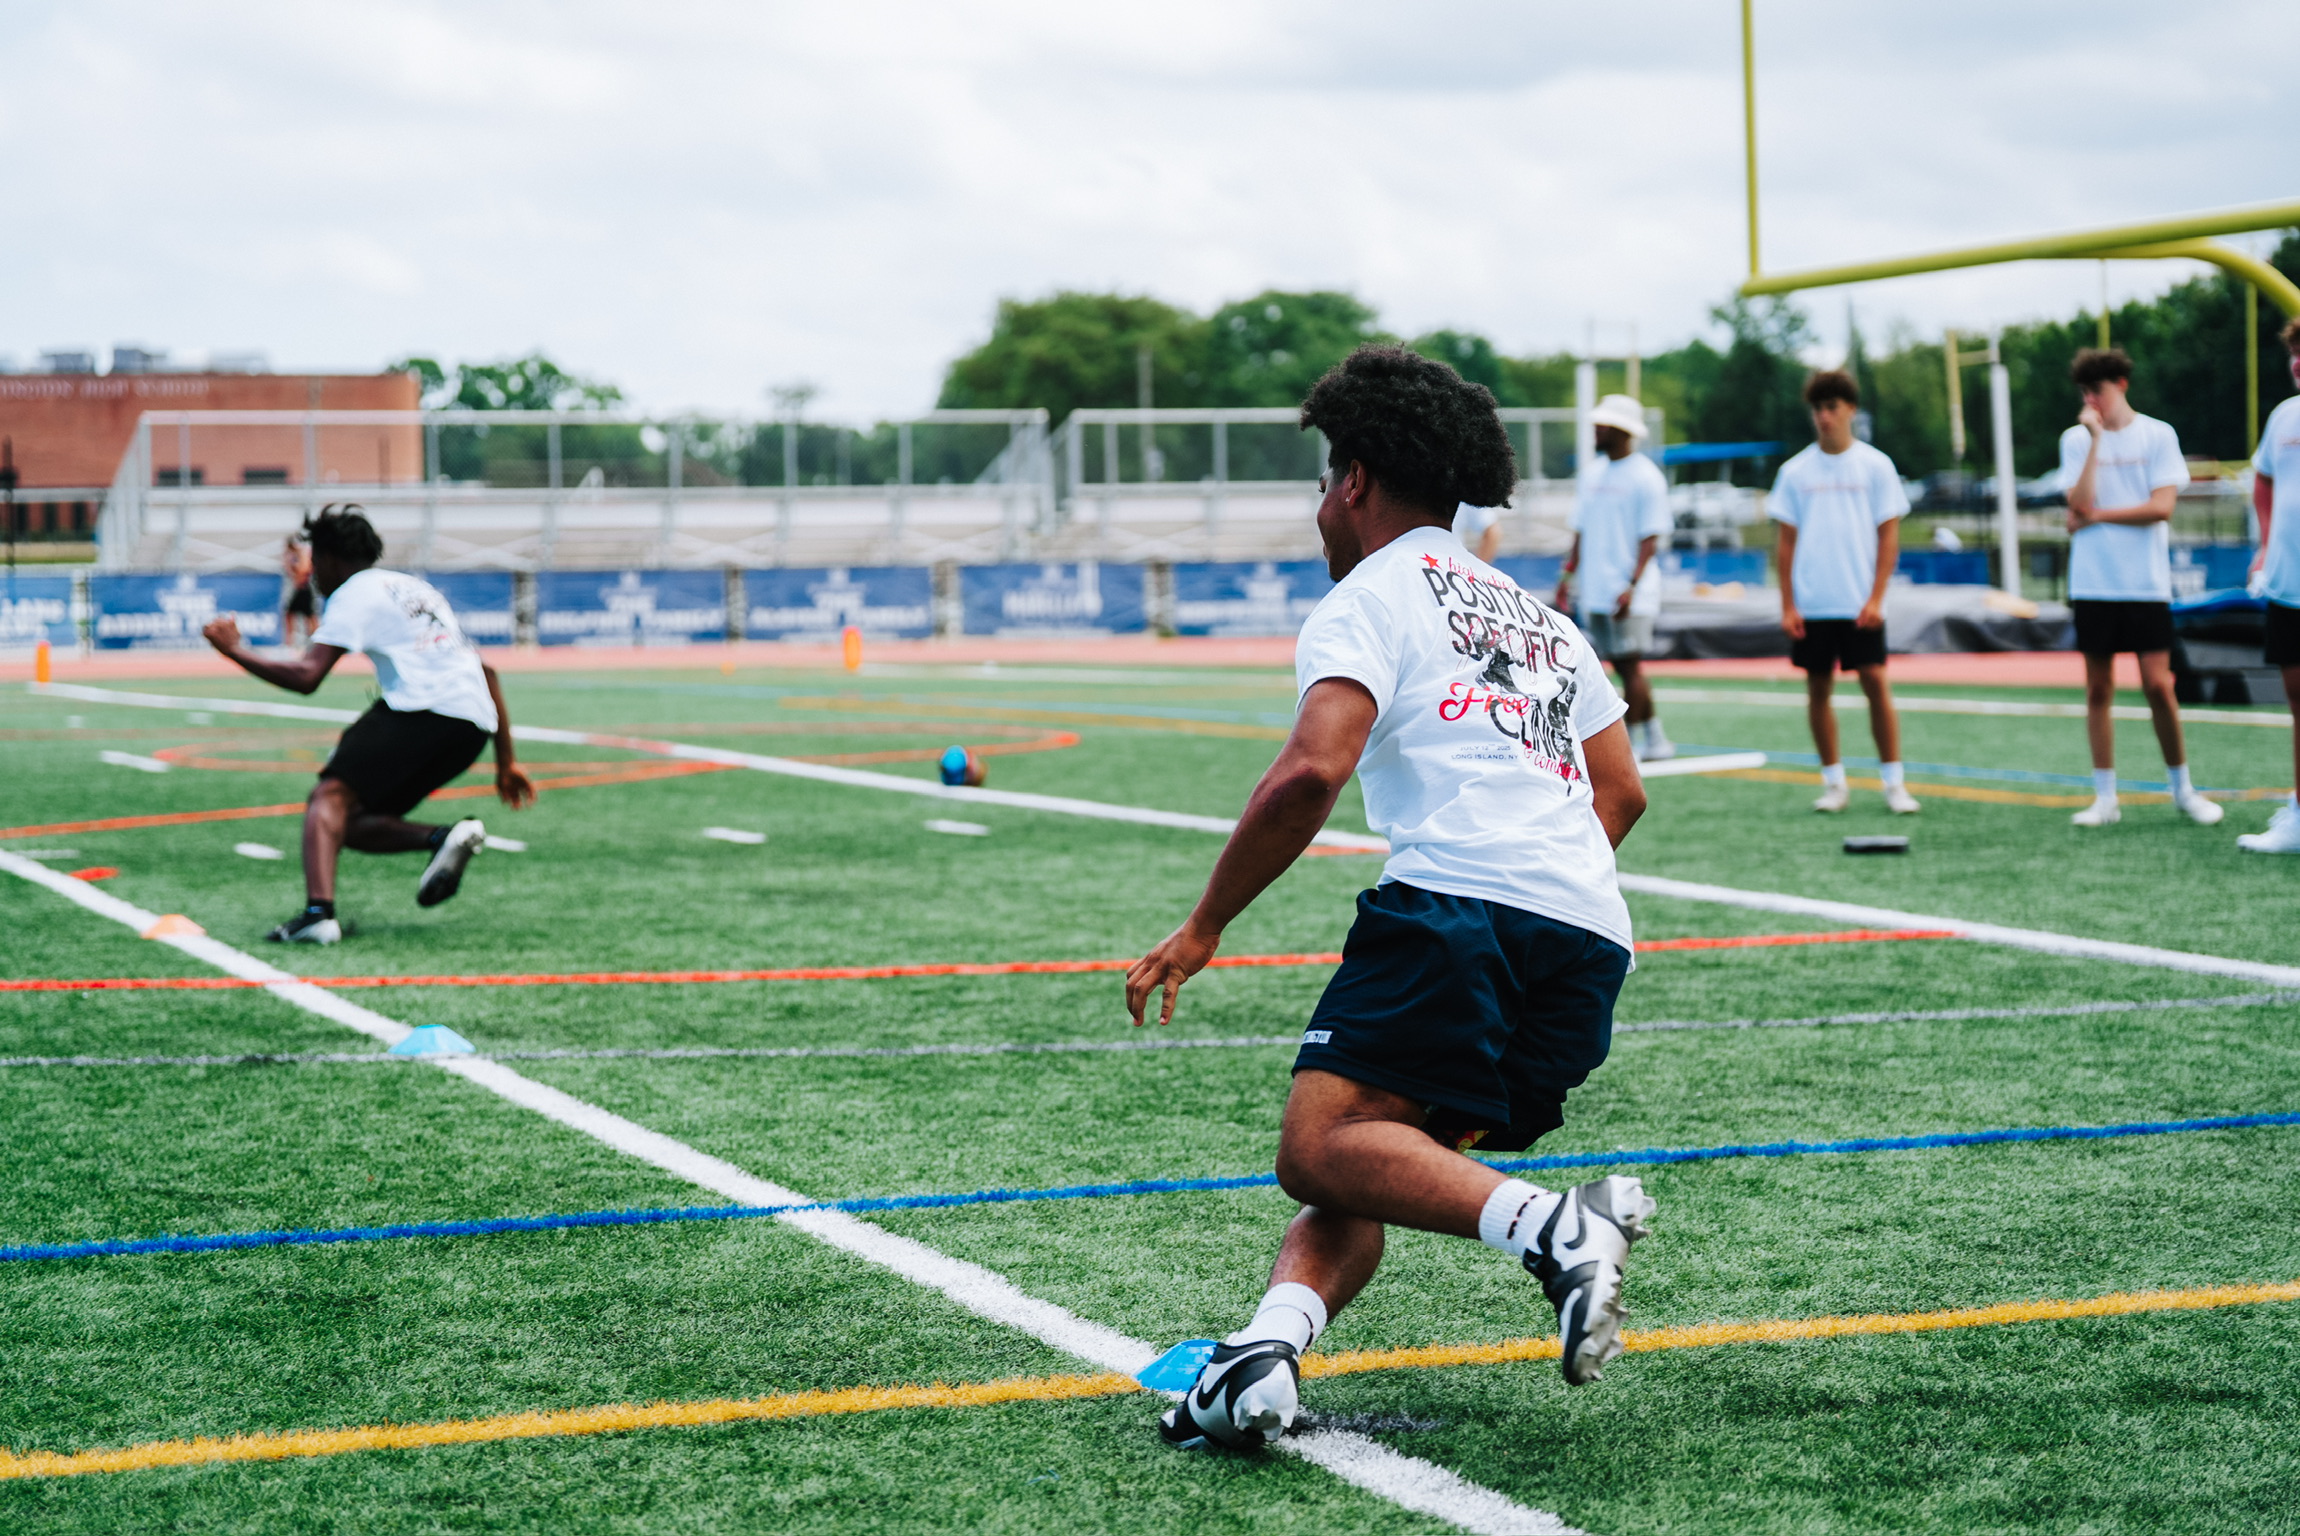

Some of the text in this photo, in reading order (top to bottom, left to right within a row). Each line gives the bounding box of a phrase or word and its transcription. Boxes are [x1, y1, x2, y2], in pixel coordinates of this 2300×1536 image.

[1422, 567, 1566, 635] POSITION
[1448, 610, 1577, 675] SPECIFIC
[1439, 682, 1530, 721] Free
